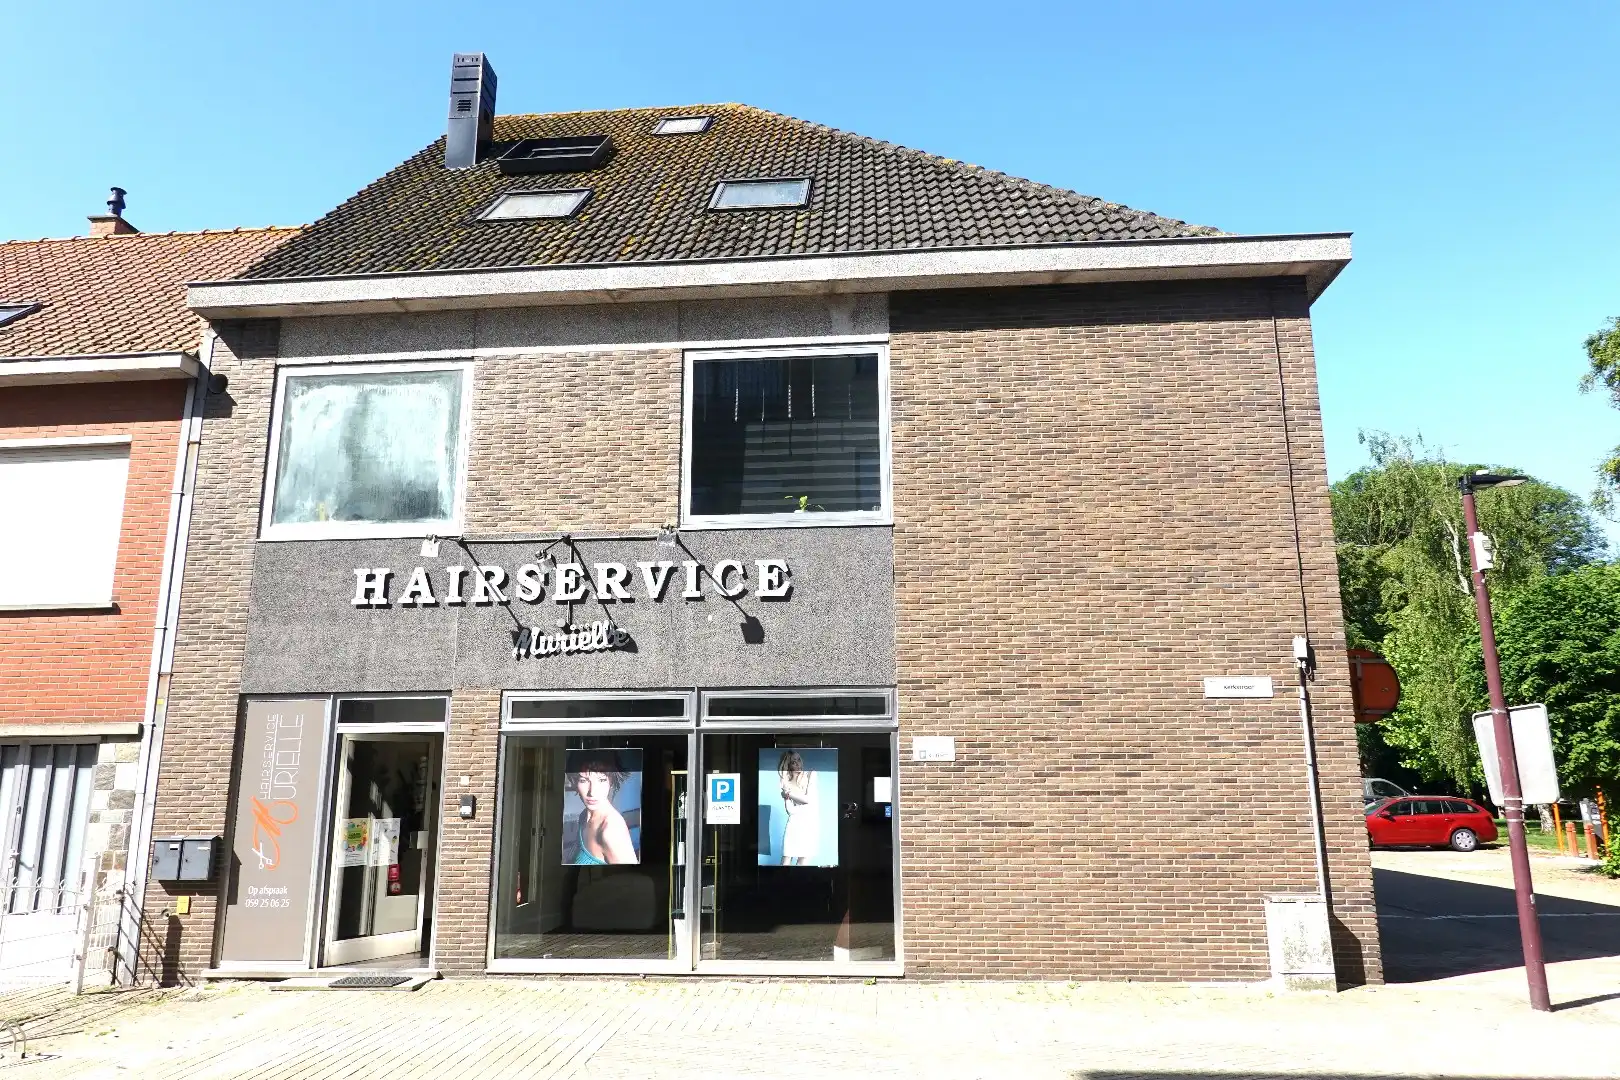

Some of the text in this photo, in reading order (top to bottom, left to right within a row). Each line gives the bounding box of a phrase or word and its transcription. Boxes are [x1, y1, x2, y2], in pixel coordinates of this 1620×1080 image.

[351, 558, 792, 606] HAIRSERVICE
[260, 714, 276, 799] HAIRSERVICE
[716, 781, 730, 800] P
[248, 886, 288, 896] Op afspraak
[245, 899, 290, 908] 059 25 06 25
